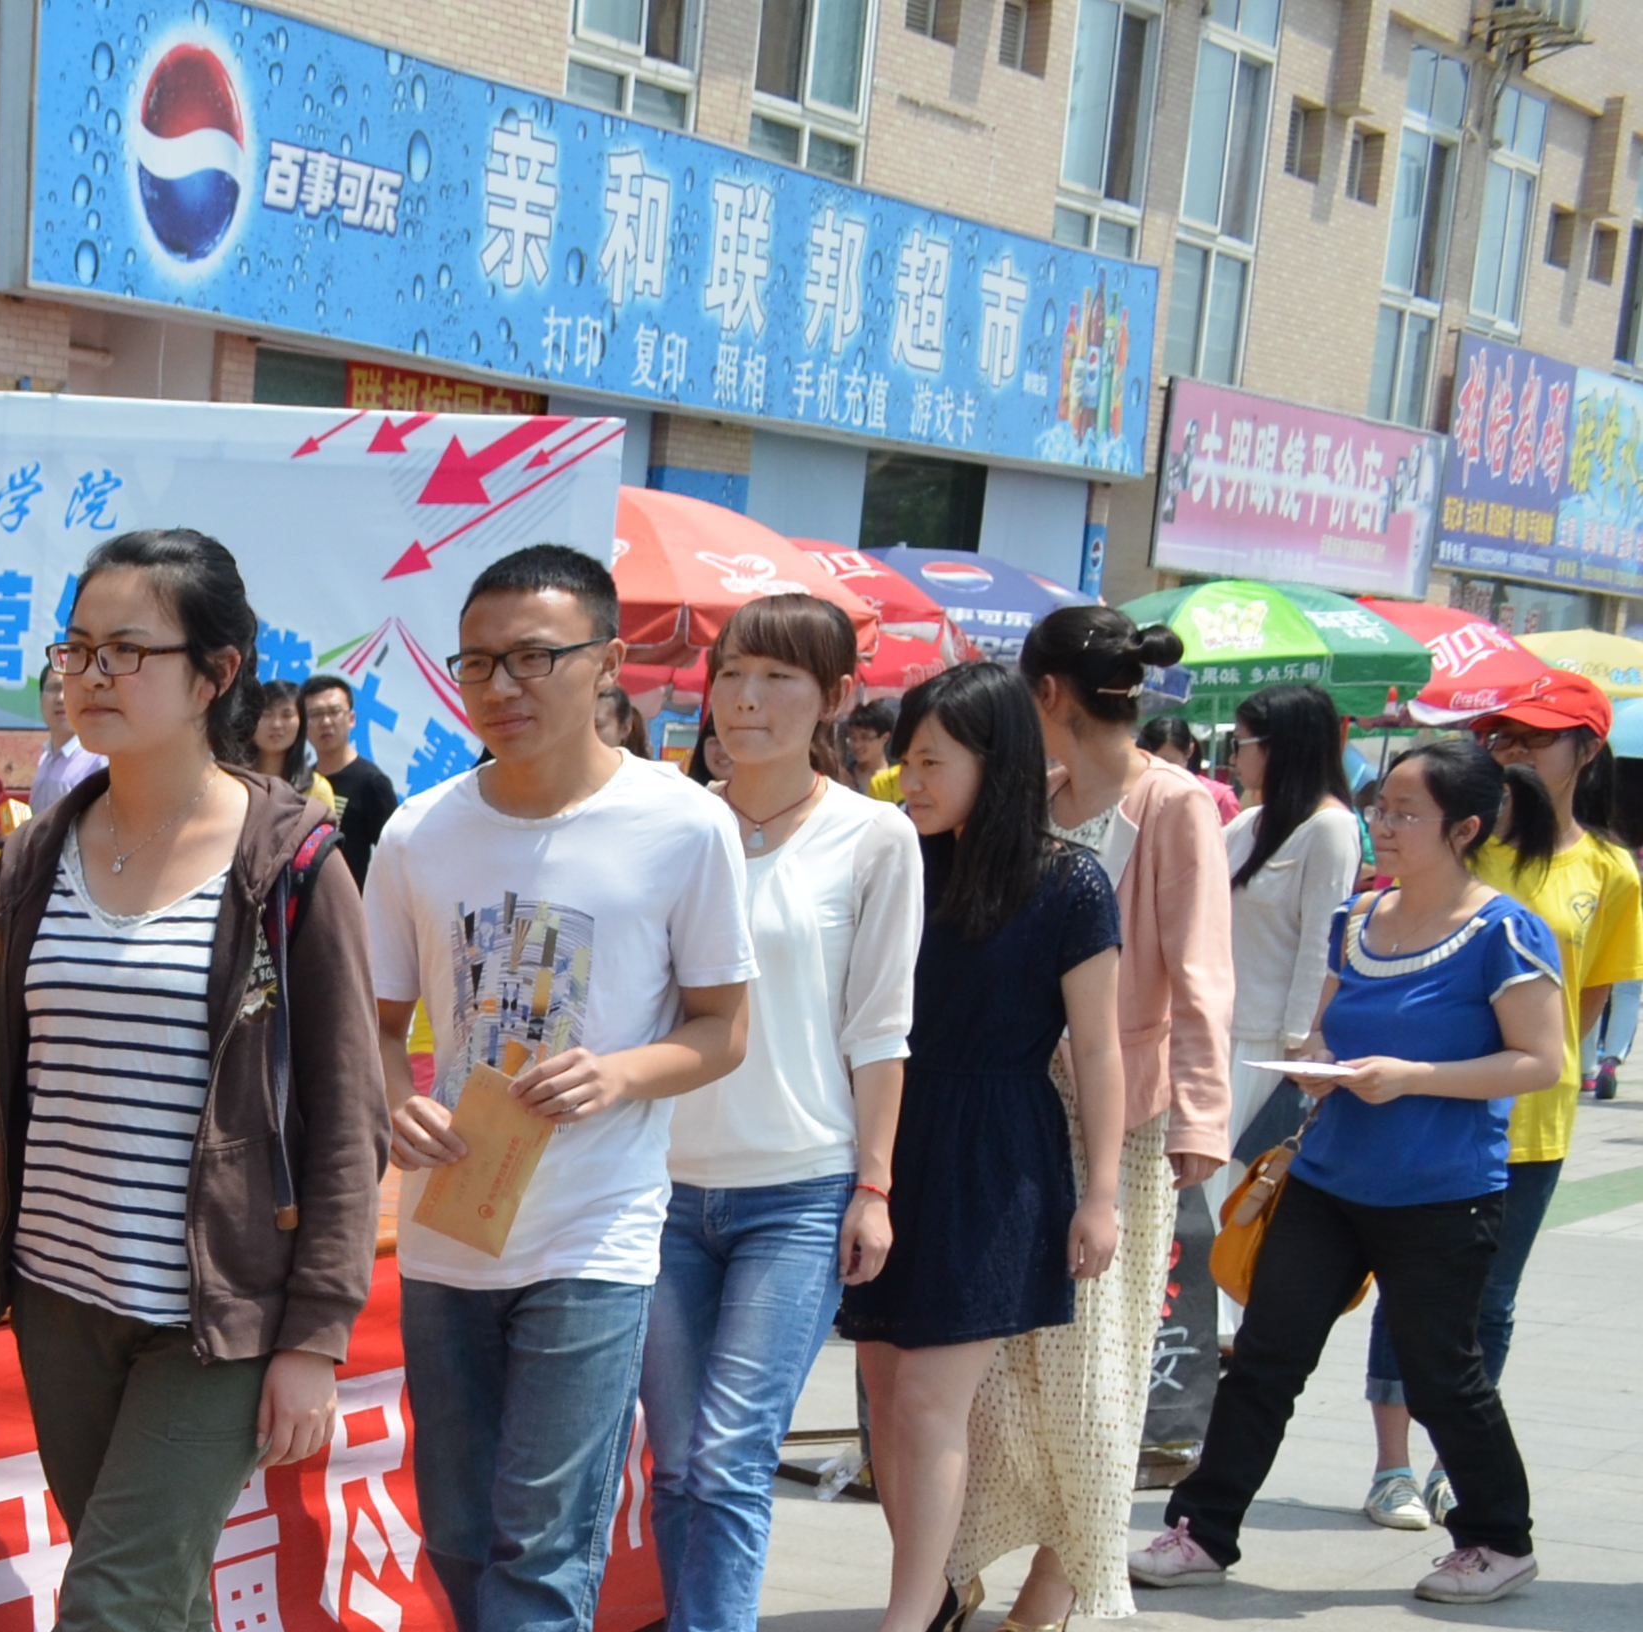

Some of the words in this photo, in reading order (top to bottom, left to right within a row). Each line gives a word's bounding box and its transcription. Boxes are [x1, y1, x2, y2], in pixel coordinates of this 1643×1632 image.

[263, 140, 404, 235] 百事可乐
[481, 119, 1027, 388] 亲和联邦超市
[541, 305, 603, 376] 打印
[631, 322, 689, 393] 复印
[713, 338, 767, 408] 照相
[792, 361, 890, 435] 手机充值
[909, 382, 976, 446] 游戏卡
